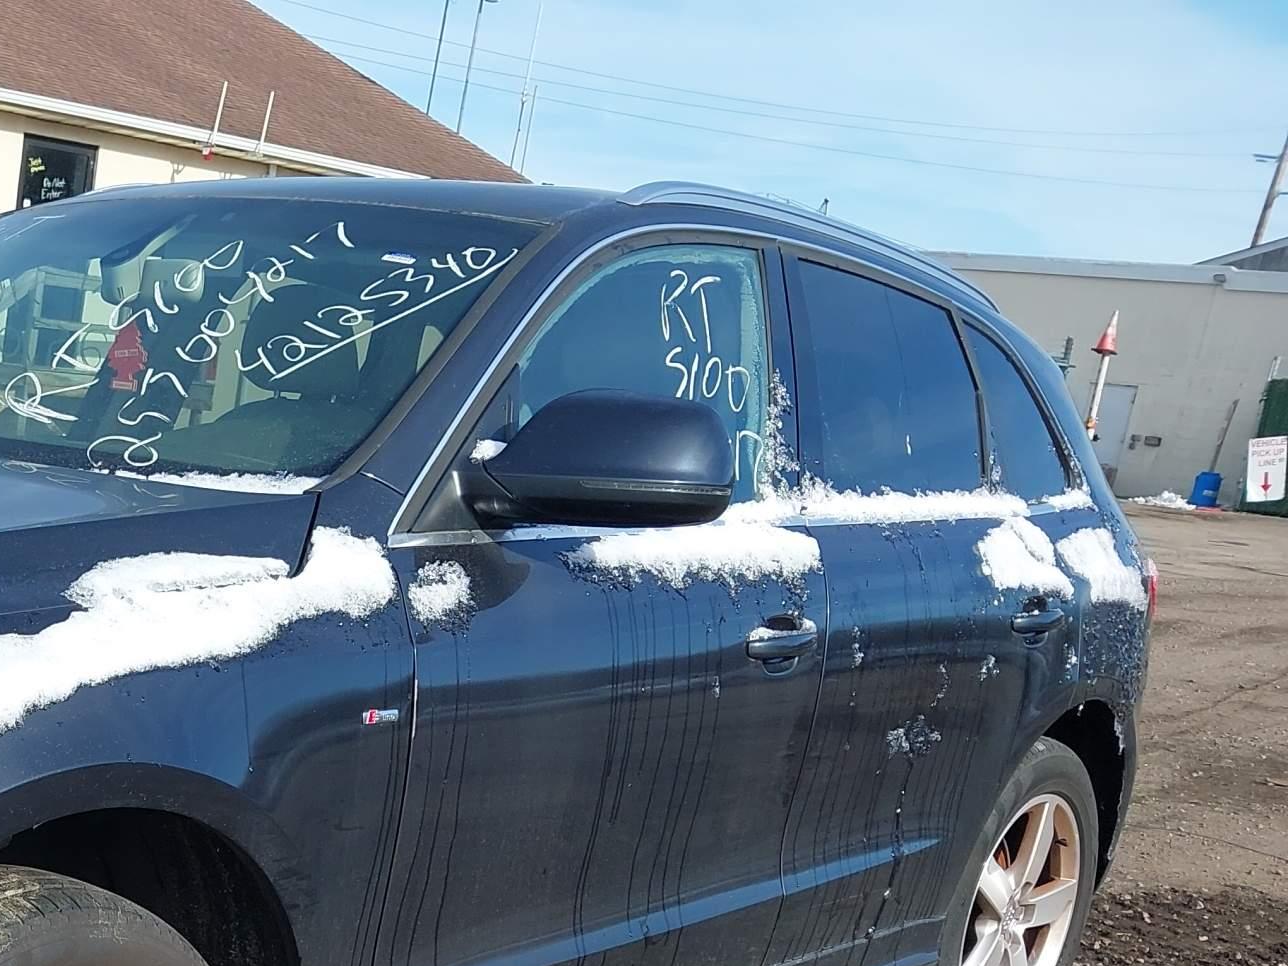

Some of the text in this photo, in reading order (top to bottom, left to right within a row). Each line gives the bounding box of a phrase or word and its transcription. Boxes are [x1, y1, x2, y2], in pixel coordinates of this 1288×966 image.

[41, 188, 64, 200] Enter
[235, 247, 497, 376] 42125340
[661, 270, 721, 354] RT
[1252, 438, 1287, 447] VEHICLE
[1252, 448, 1285, 457] PICK UP
[1258, 458, 1277, 467] LINE
